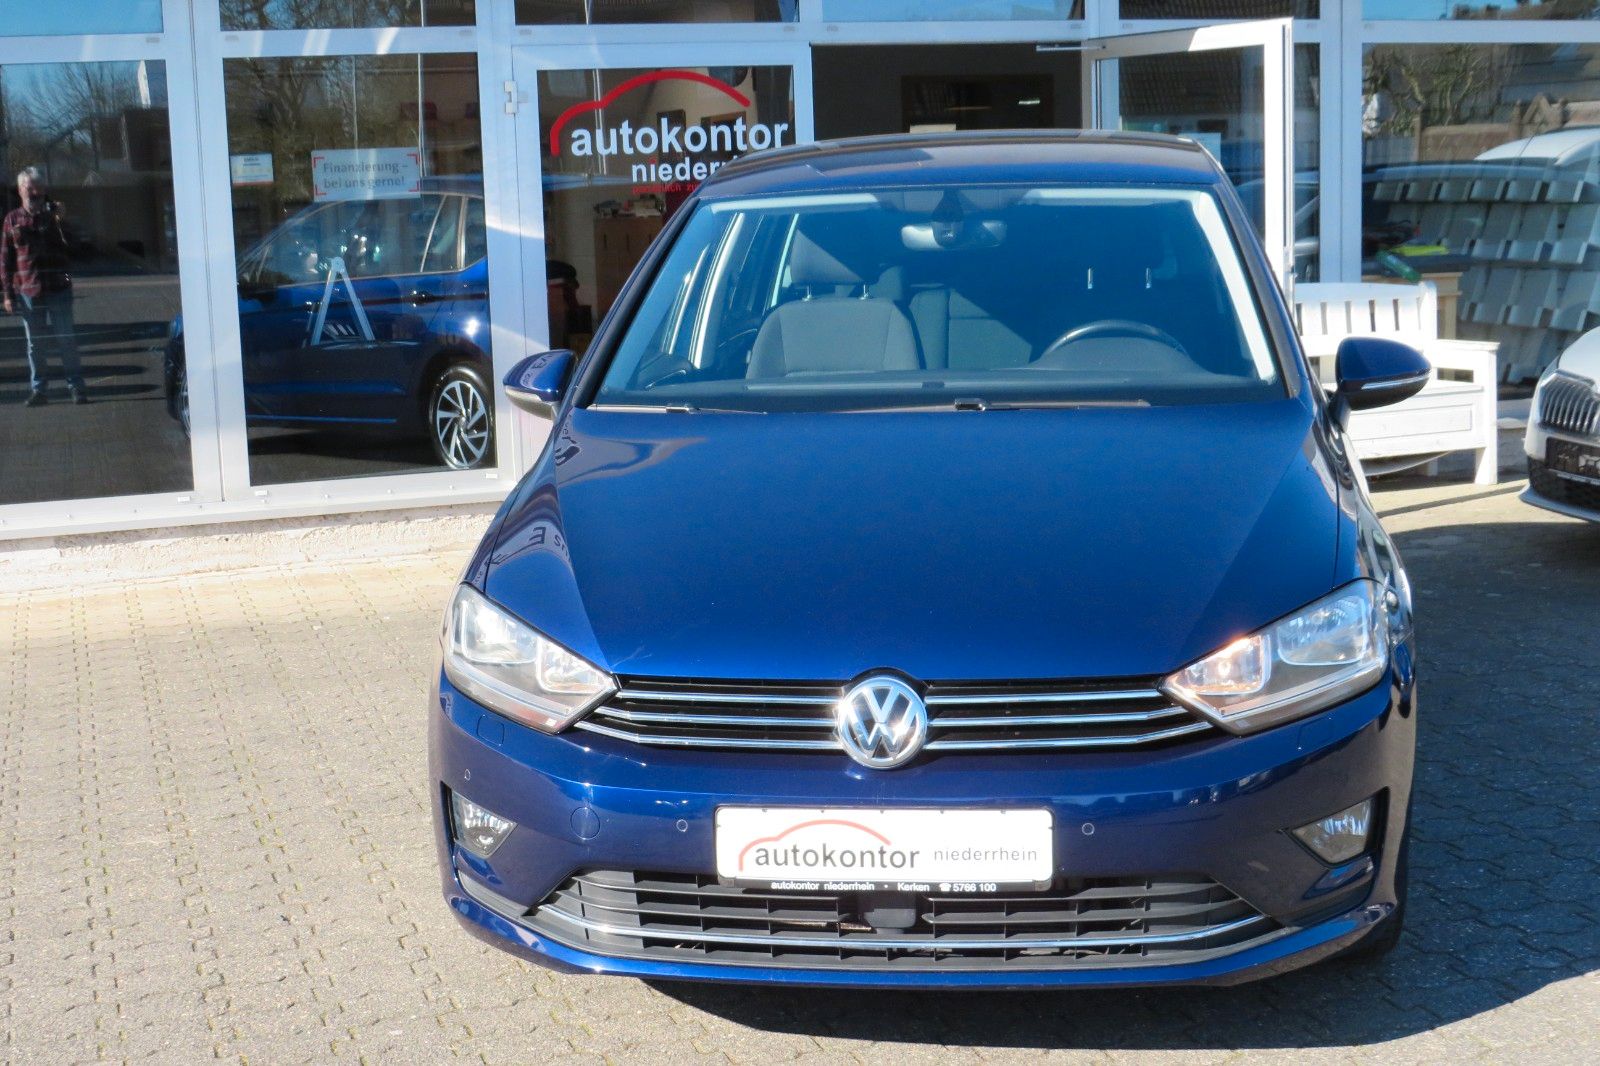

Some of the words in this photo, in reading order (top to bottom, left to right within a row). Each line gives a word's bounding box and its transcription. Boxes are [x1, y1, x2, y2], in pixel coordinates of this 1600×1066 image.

[571, 117, 788, 156] autokontor
[323, 160, 399, 174] Finanzierung
[324, 178, 341, 189] bei
[345, 179, 365, 188] uns
[755, 844, 919, 868] autokontor
[934, 848, 1037, 861] niederrhein
[771, 881, 819, 890] autokontor
[824, 882, 875, 891] niederrhein
[897, 882, 930, 891] Kerken
[953, 883, 976, 892] 5766
[979, 883, 997, 892] 100
